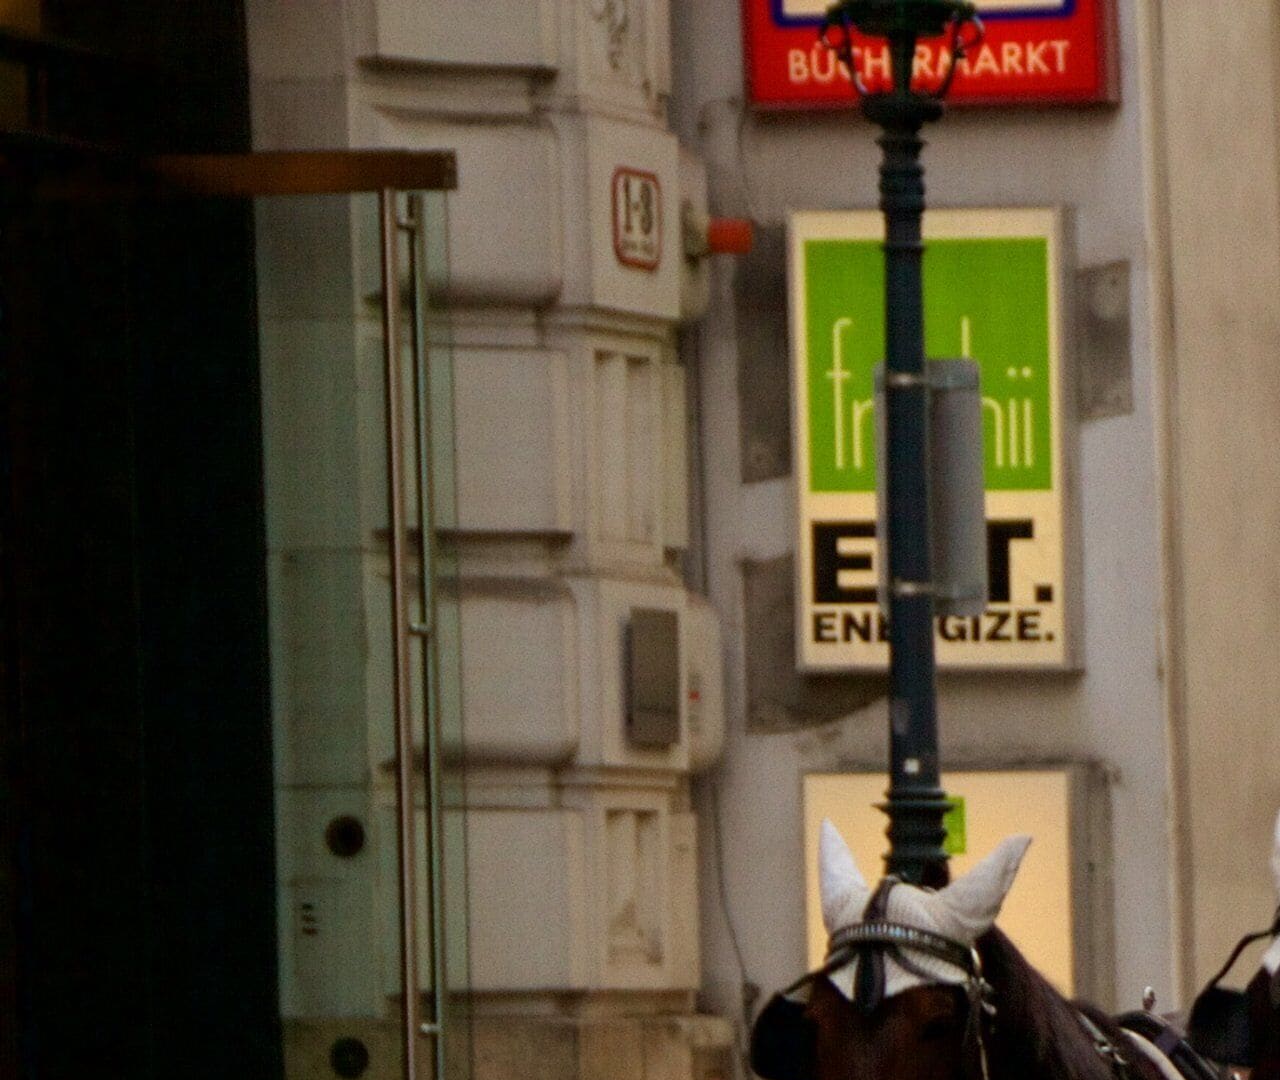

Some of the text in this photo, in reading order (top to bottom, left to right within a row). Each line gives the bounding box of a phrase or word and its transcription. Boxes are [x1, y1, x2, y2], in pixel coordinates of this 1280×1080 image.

[787, 39, 1070, 83] BÜCHRMARKT
[826, 317, 1036, 470] frhii
[811, 519, 1054, 604] ET.
[812, 610, 1055, 643] ENEGIZE.
